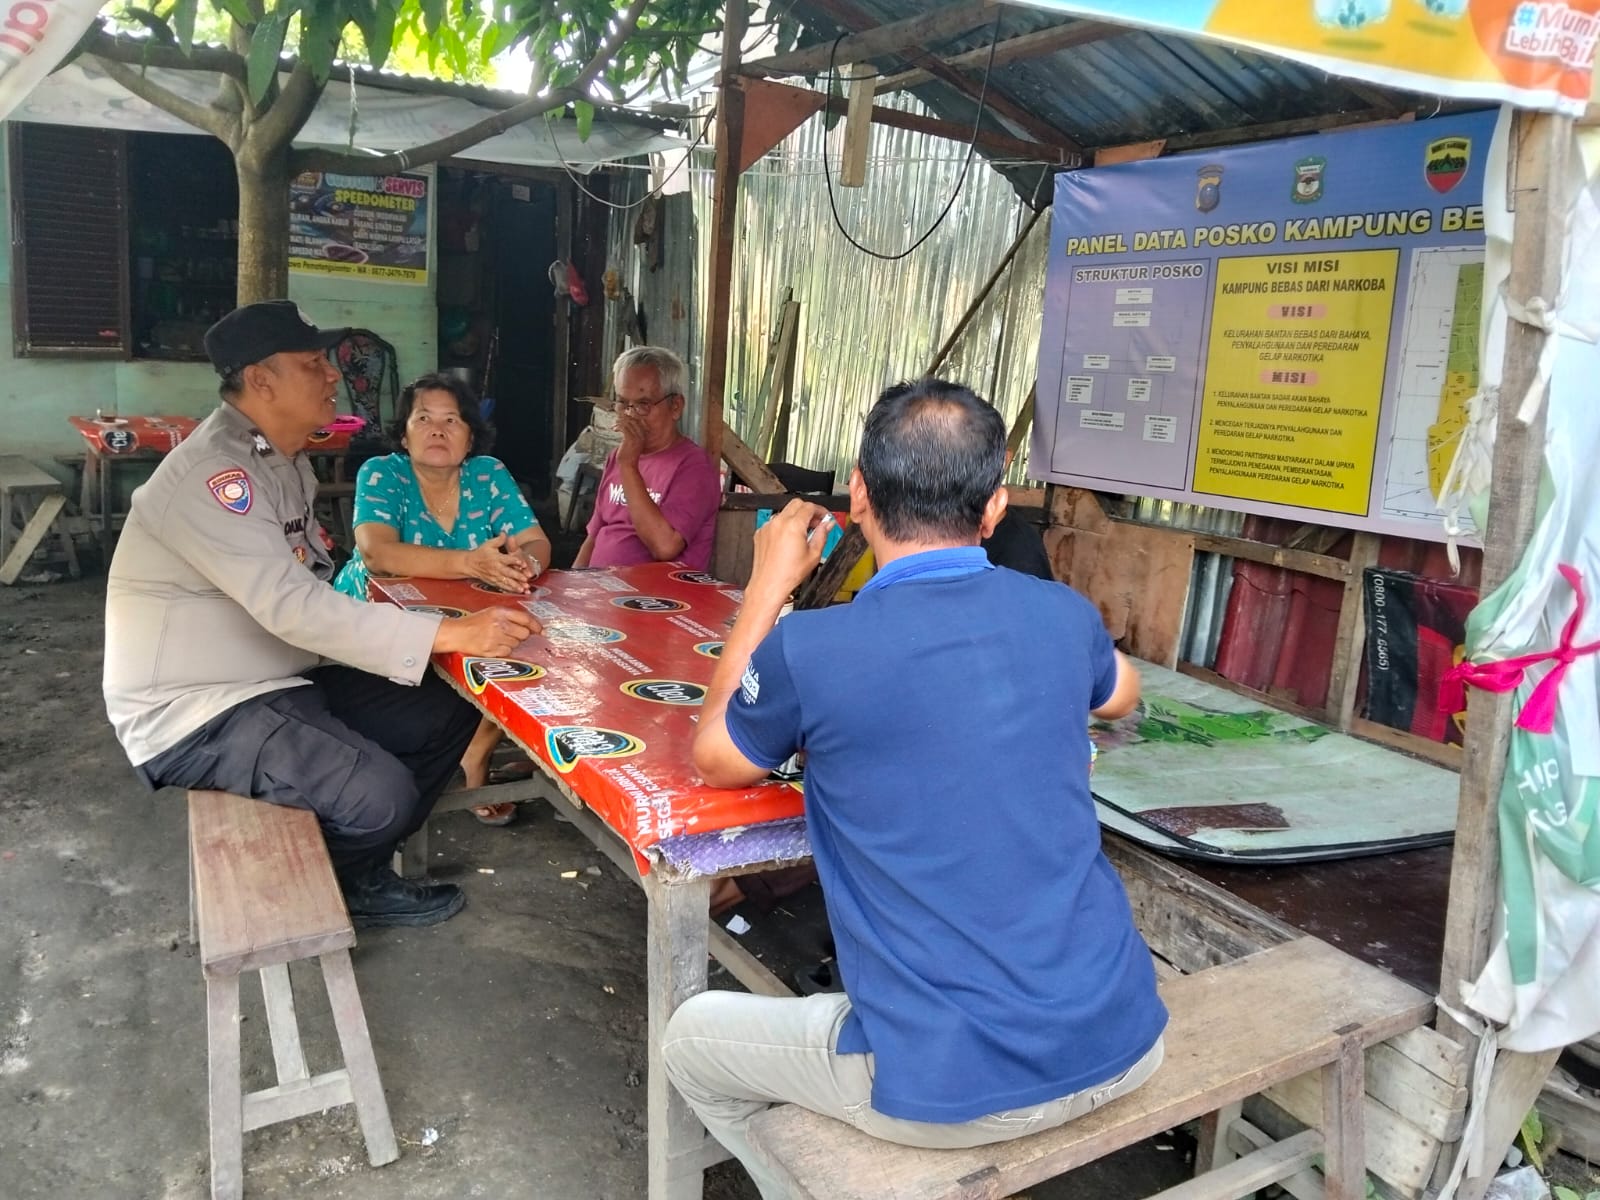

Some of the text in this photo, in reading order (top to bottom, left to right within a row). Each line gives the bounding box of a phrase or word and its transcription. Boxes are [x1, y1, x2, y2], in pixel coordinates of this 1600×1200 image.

[384, 175, 426, 198] SERVIS
[335, 189, 416, 212] SPEEDOMETER
[1066, 233, 1128, 257] PANEL
[1132, 227, 1188, 252] DATA
[1192, 220, 1277, 248] POSKO
[1284, 207, 1433, 242] KAMPUNG
[1075, 263, 1204, 283] STRUKTUR POSKO
[1266, 259, 1340, 275] VISI MISI
[1221, 277, 1386, 296] KAMPUNG BEBAS DARI NARKOBA
[1281, 306, 1313, 318] VISI
[1224, 329, 1263, 338] KELURAHAN
[1319, 329, 1338, 339] DARI
[1313, 341, 1360, 352] PEREDARAN
[1259, 353, 1324, 363] GELAP NARKOTIKA
[1271, 371, 1306, 384] MISI
[646, 683, 691, 701] Cleo
